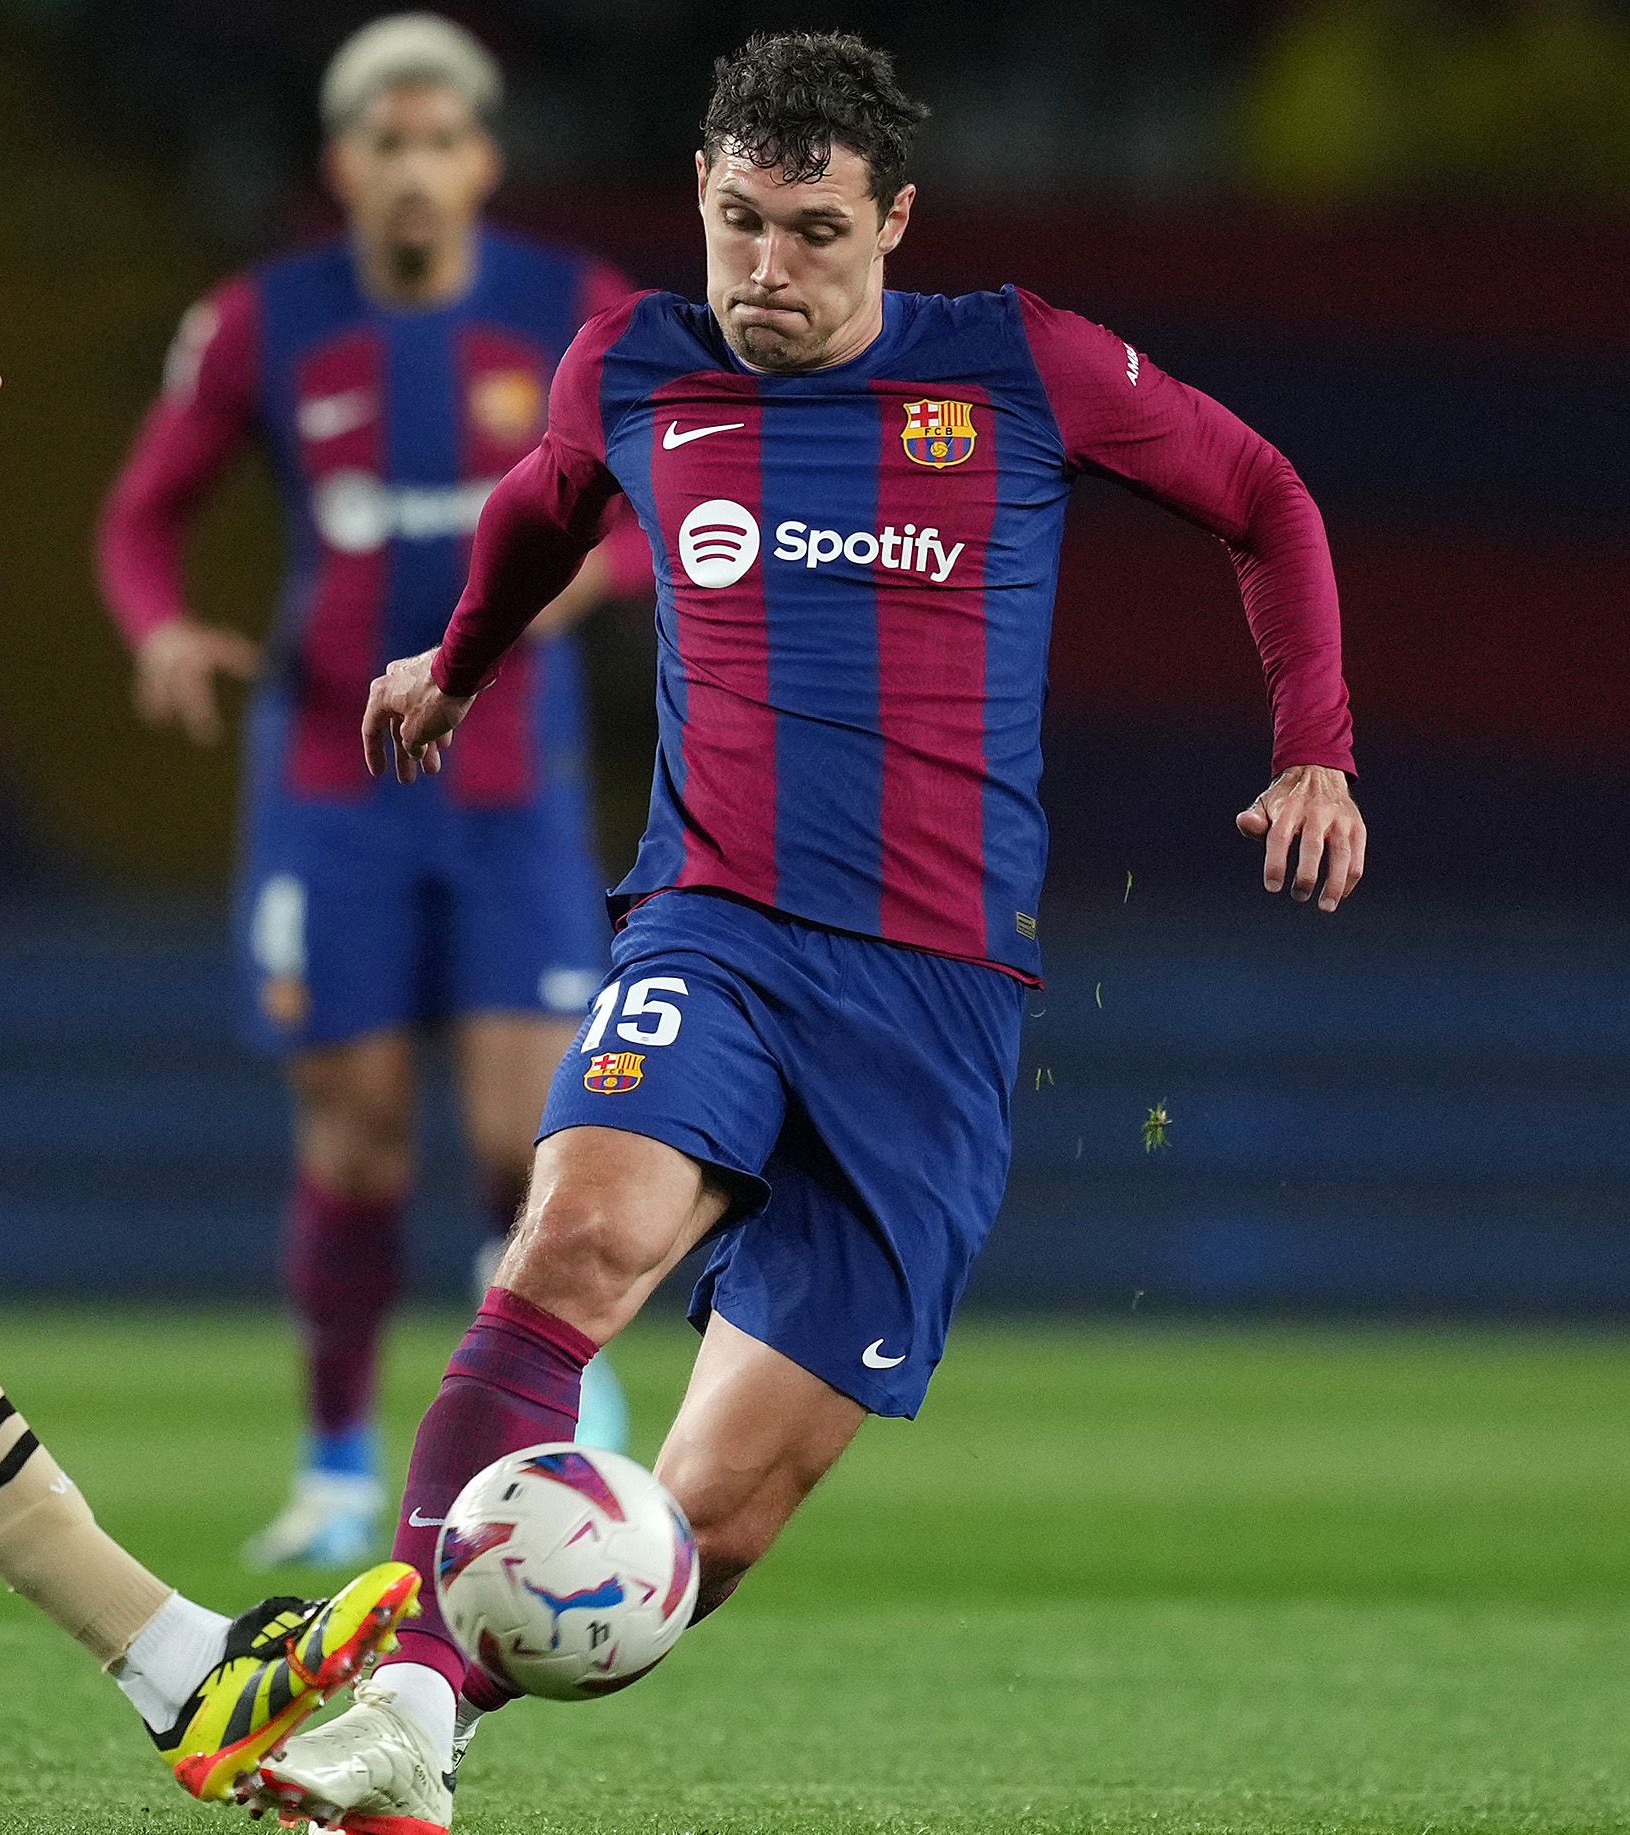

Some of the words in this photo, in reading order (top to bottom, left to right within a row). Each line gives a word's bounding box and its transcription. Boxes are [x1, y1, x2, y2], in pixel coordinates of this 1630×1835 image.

[925, 427, 953, 436] FCB
[773, 520, 965, 583] Spotify
[580, 976, 690, 1054] 15
